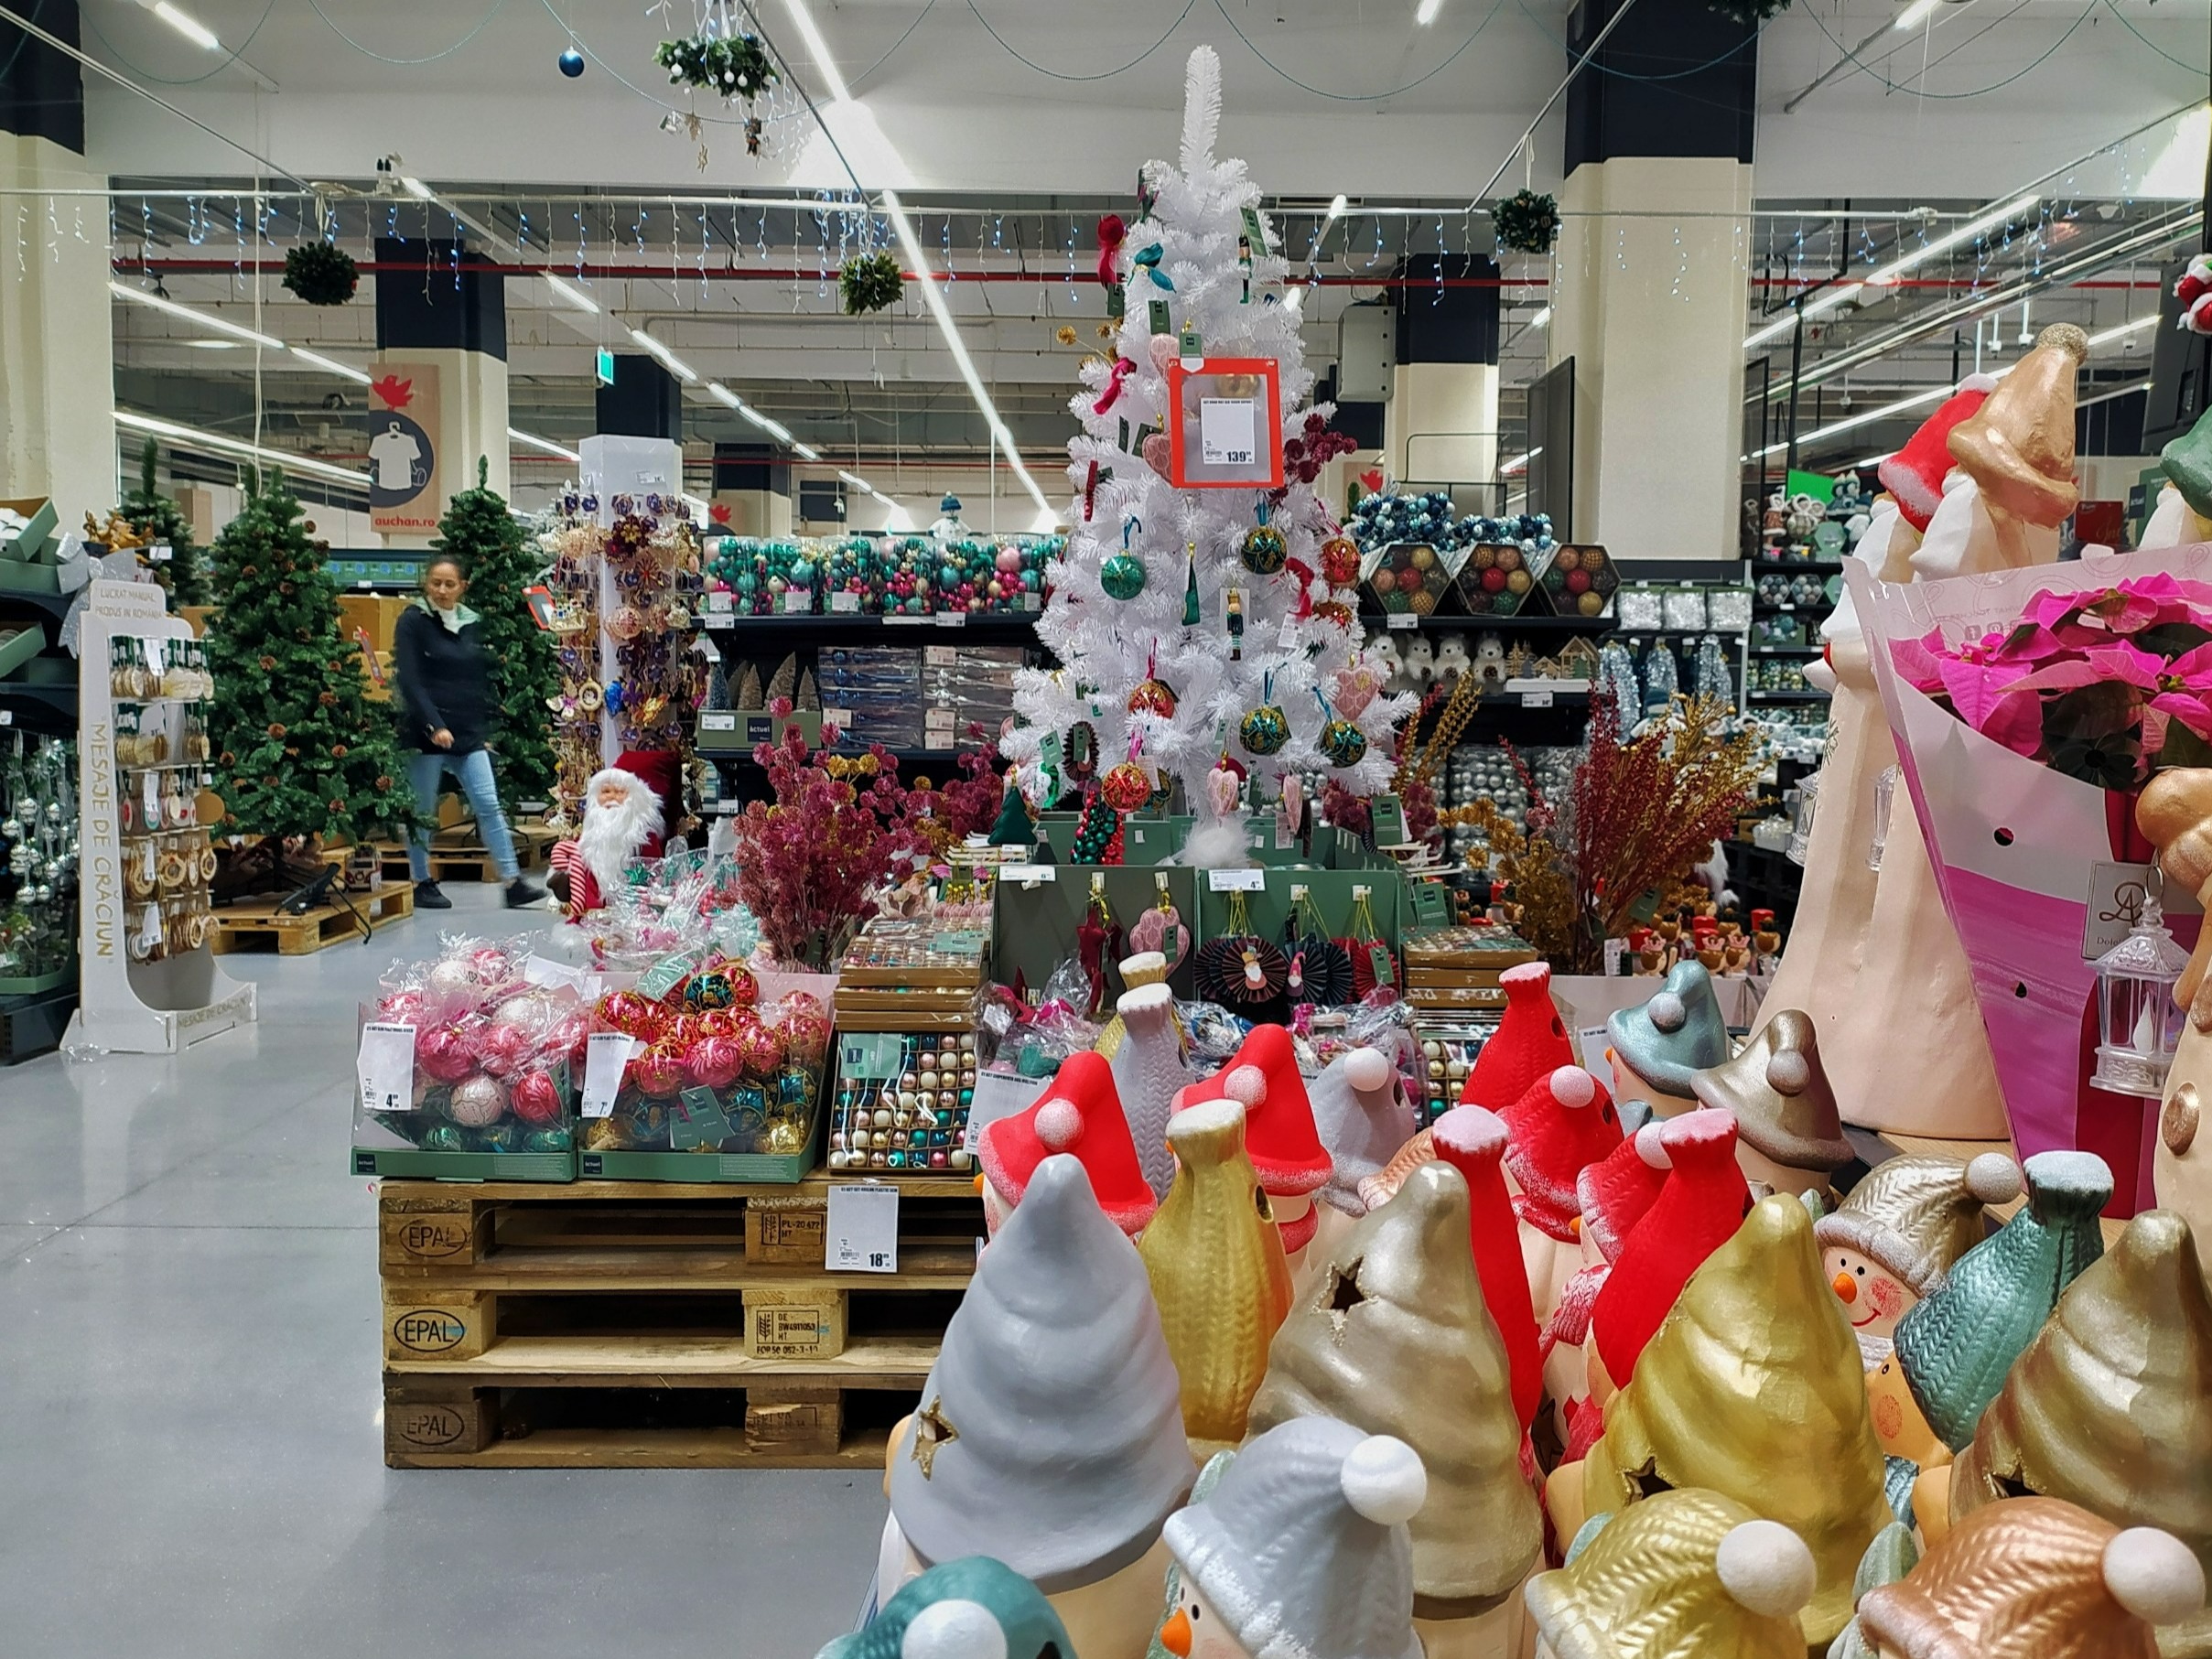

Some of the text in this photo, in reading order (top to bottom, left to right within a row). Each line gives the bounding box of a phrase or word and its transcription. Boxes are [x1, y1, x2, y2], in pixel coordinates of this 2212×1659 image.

[1226, 451, 1246, 462] 139
[374, 514, 436, 528] auchan.ro
[100, 587, 156, 602] LUCRAT MANUAL
[94, 606, 122, 617] PRODUS
[92, 819, 112, 848] DE
[386, 1093, 393, 1107] 4
[408, 1226, 459, 1248] EPAL
[869, 1253, 883, 1267] 18
[778, 1313, 788, 1321] DE
[405, 1320, 454, 1342] EPAL
[406, 1415, 453, 1437] EPAL
